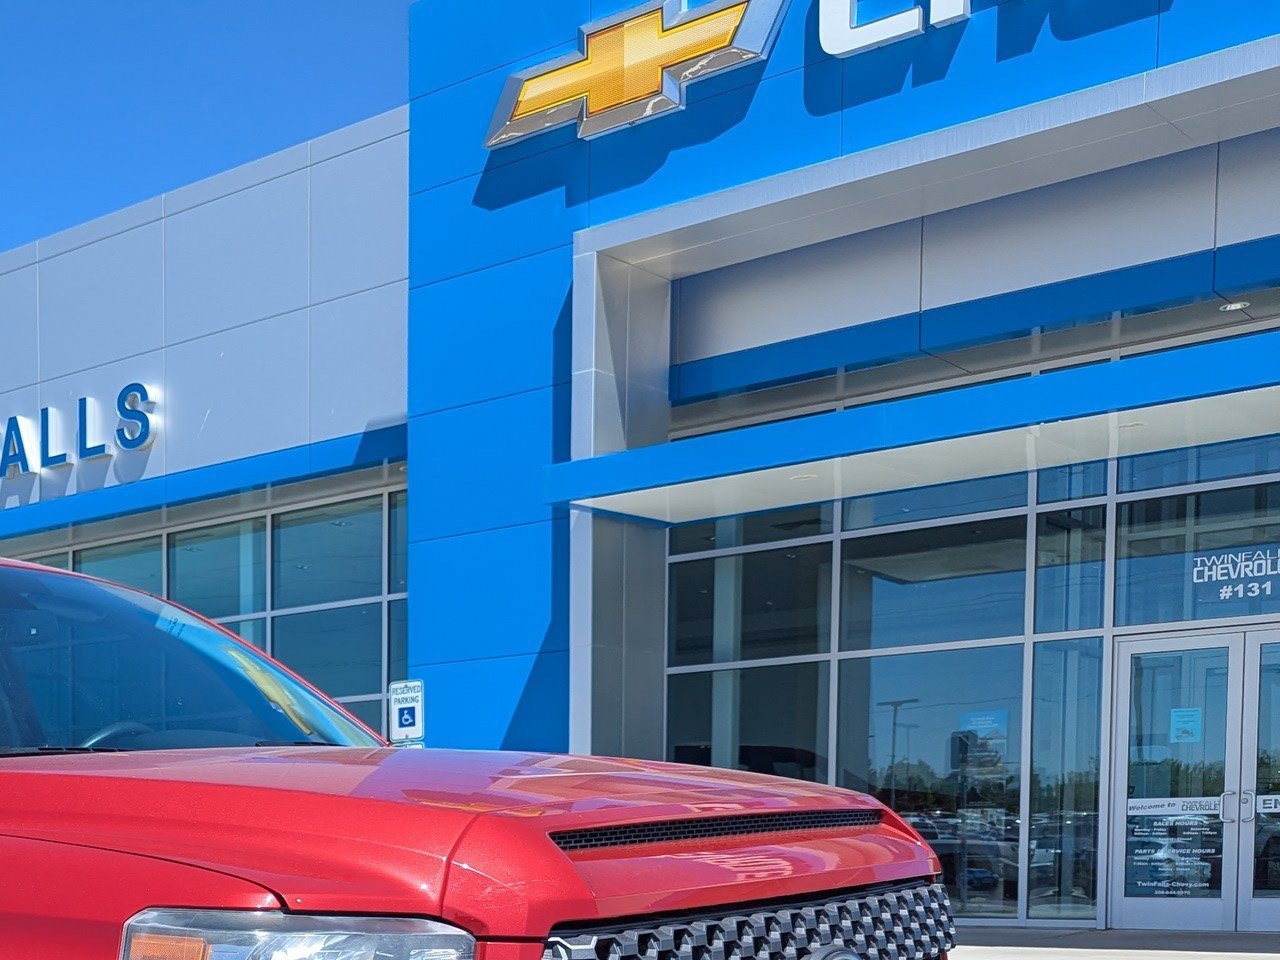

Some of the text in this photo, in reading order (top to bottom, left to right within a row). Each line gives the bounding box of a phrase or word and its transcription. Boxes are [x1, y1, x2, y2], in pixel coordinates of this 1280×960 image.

[1219, 581, 1272, 600] #131
[392, 685, 421, 694] RESERVED
[393, 696, 420, 705] PARKING
[1129, 804, 1165, 812] Welcome
